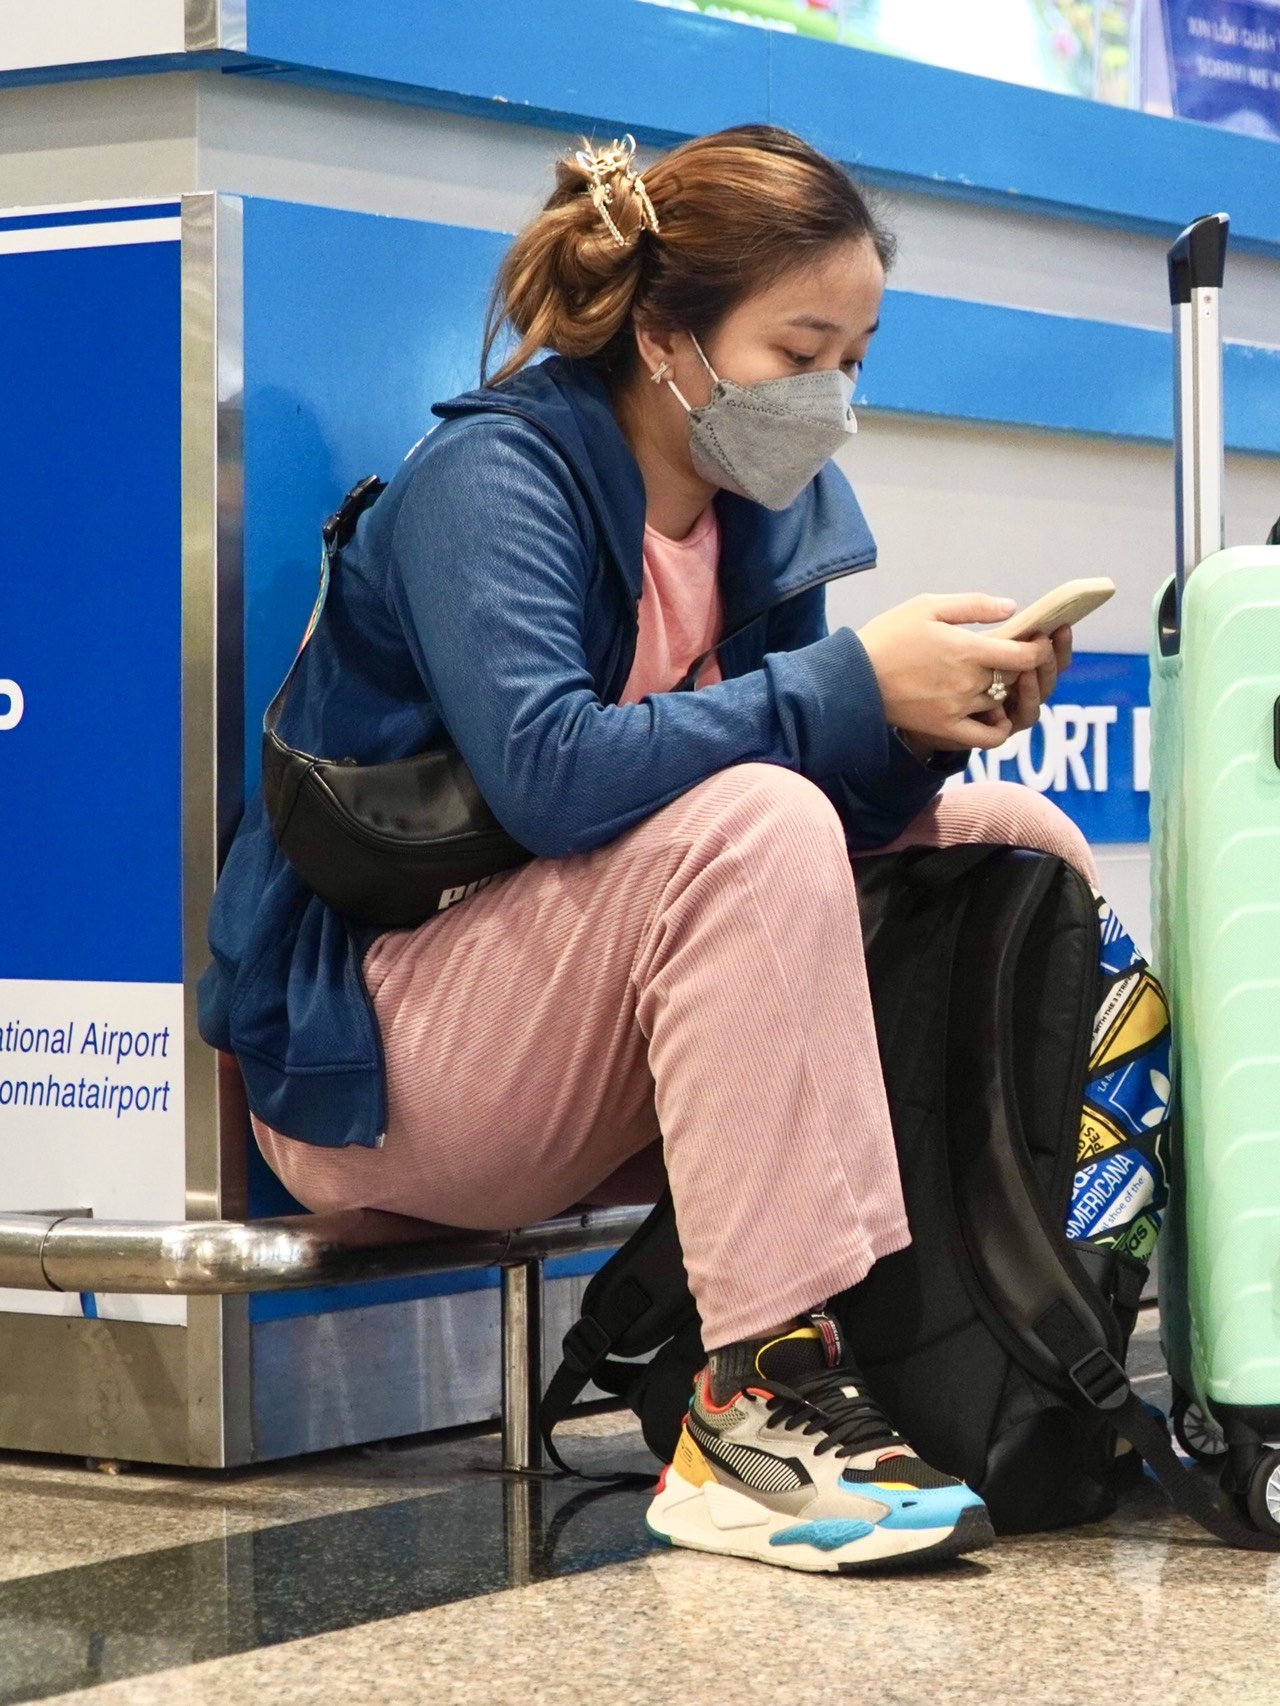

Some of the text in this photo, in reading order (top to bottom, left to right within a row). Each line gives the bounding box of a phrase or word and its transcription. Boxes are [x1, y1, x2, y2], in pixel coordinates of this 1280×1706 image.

[1104, 1002, 1116, 1017] THE
[0, 1020, 170, 1065] tional Airport
[0, 1074, 170, 1119] onnhatairport
[1065, 1154, 1134, 1239] AMERICANA
[1109, 1202, 1126, 1224] shoe
[1125, 1188, 1137, 1202] of
[1127, 1224, 1148, 1250] as
